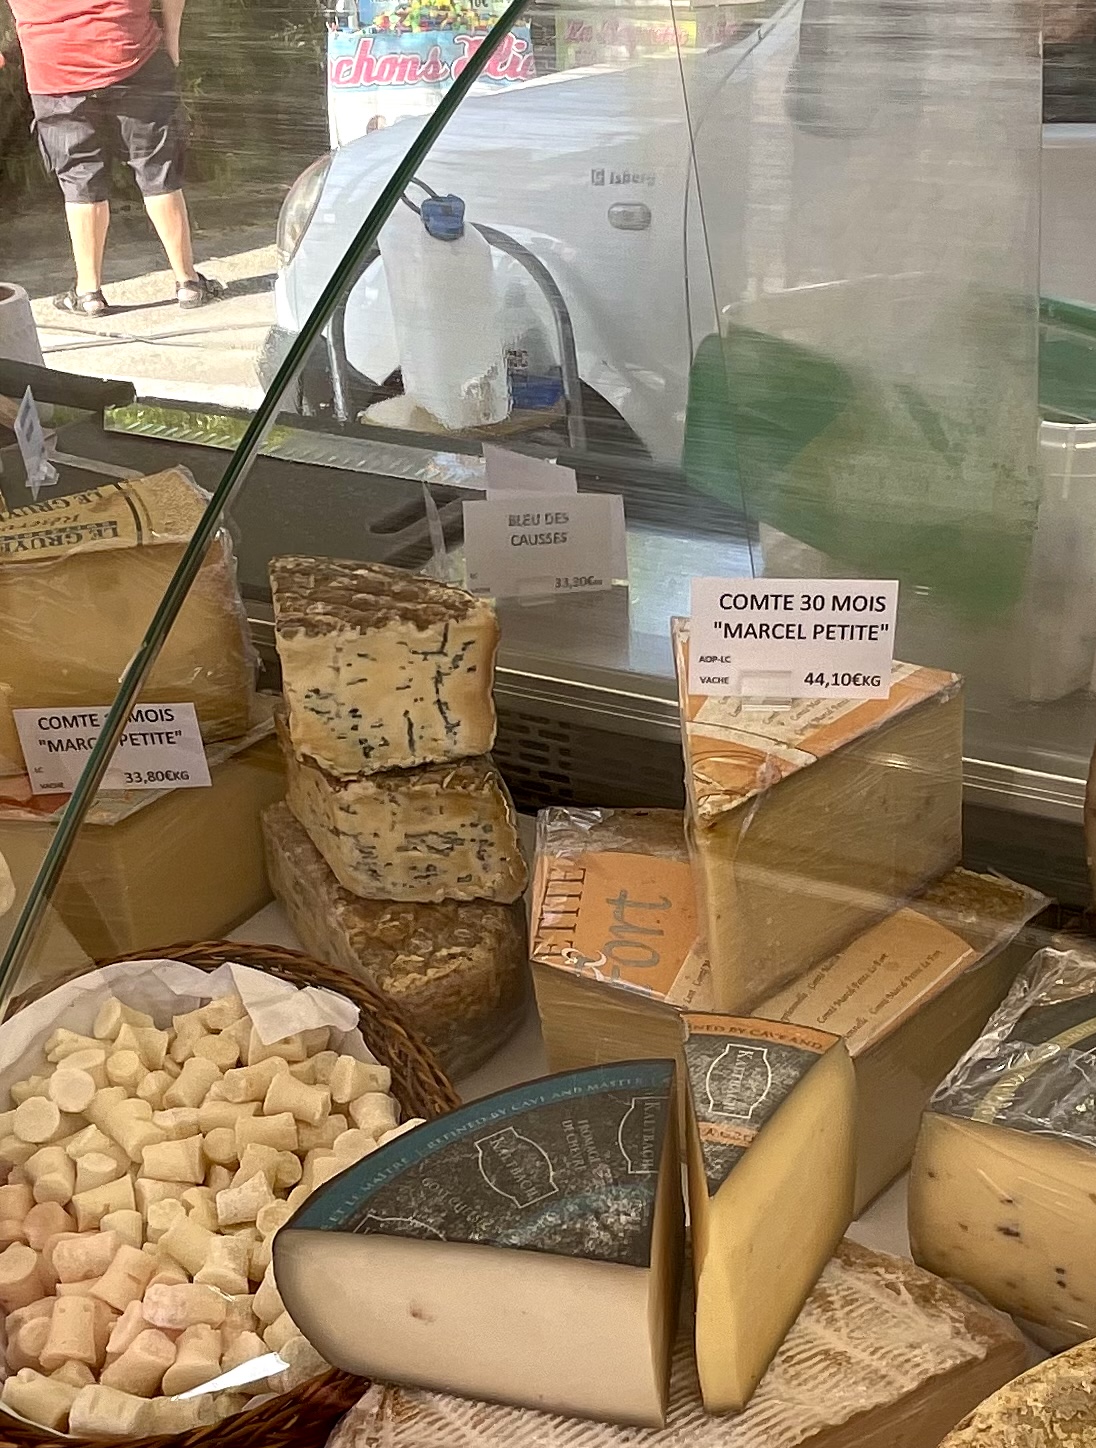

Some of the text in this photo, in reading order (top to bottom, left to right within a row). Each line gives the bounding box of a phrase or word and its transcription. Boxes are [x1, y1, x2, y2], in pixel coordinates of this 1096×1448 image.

[329, 37, 449, 86] chons
[508, 512, 569, 526] BLEU DES
[511, 532, 568, 546] CAUSSES
[719, 593, 887, 612] COMTE 30 MOIS
[713, 621, 889, 641] "MARCEL PETITE"
[699, 676, 729, 685] VACHE
[804, 672, 881, 688] 44,10€KG
[38, 713, 100, 730] COMTE
[128, 708, 175, 723] MOIS
[38, 730, 182, 753] "MARC PETITE"
[124, 770, 189, 785] 33,80€KG
[531, 868, 587, 957] ETITE
[426, 1115, 490, 1148] REFINED
[490, 1107, 508, 1120] BY
[509, 1095, 547, 1114] CAVE
[552, 1085, 584, 1099] AND
[643, 1101, 661, 1169] KALTBACH
[490, 1136, 541, 1199] KALTBACH
